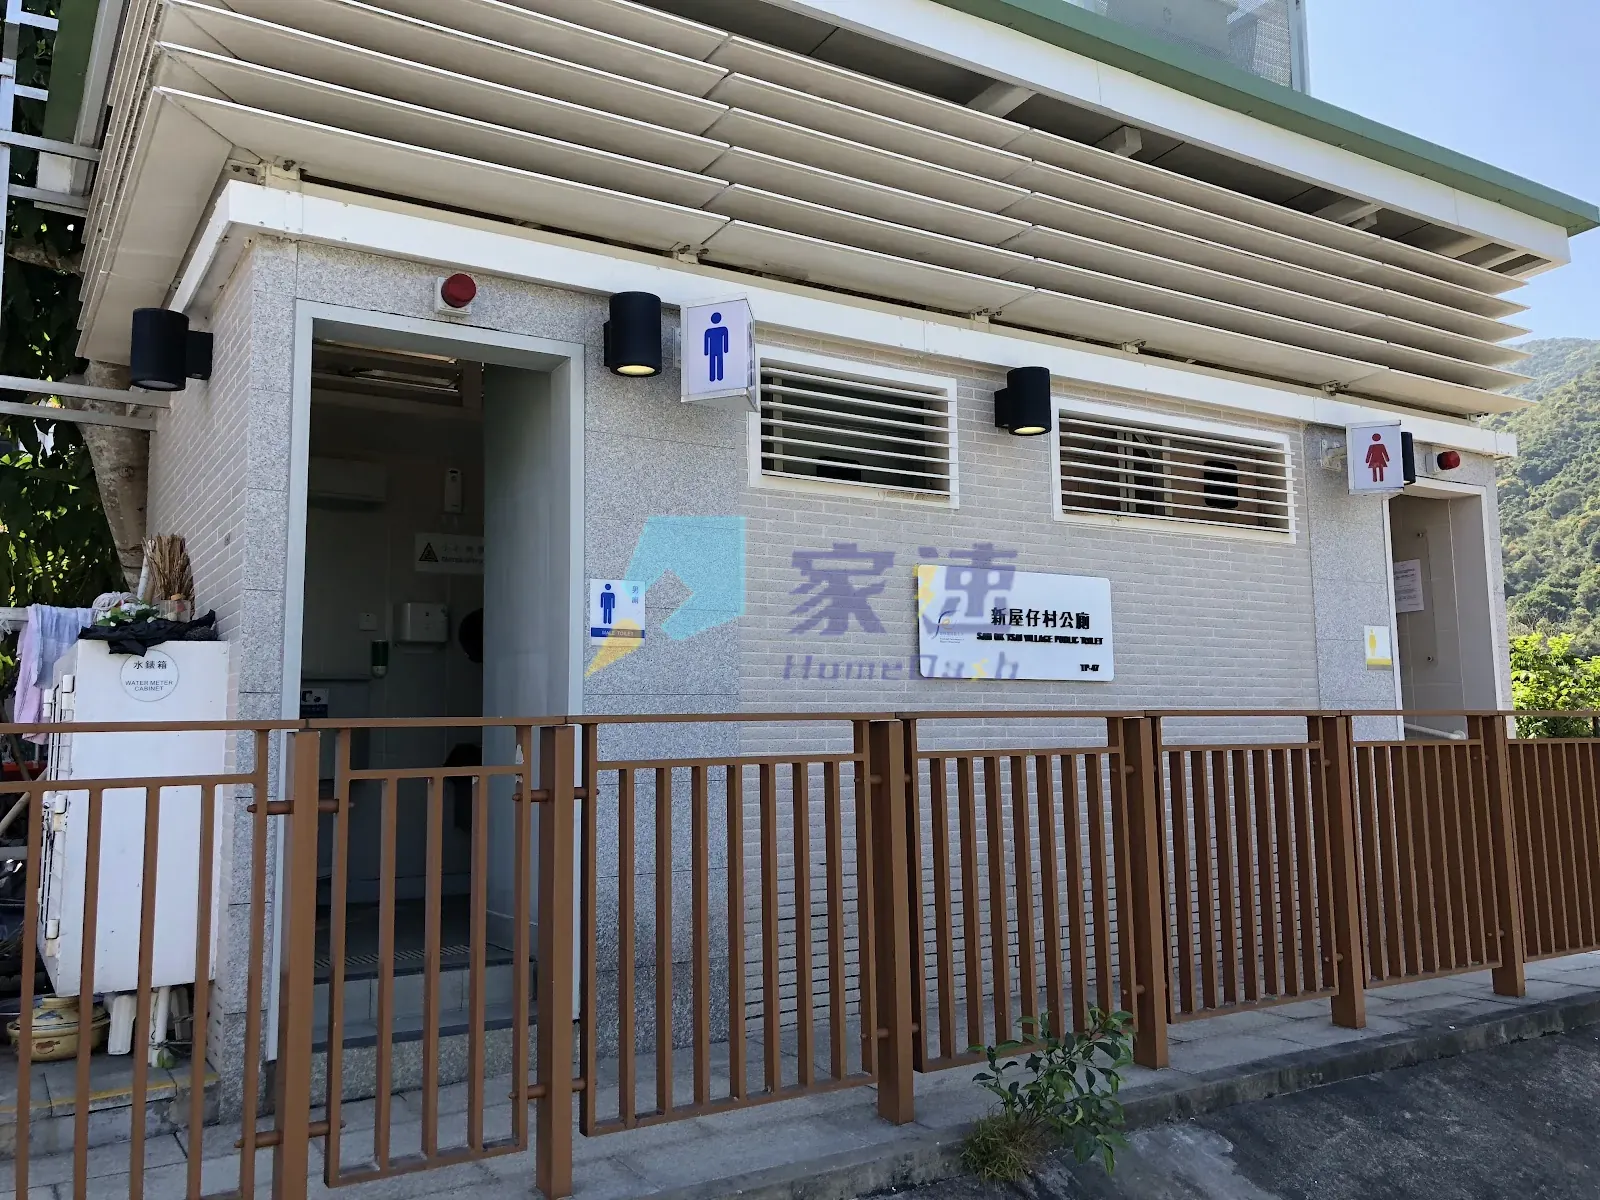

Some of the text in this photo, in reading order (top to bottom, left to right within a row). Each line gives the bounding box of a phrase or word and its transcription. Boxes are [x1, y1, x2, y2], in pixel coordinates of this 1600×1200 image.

[990, 607, 1091, 630] 新屋仔村公廁
